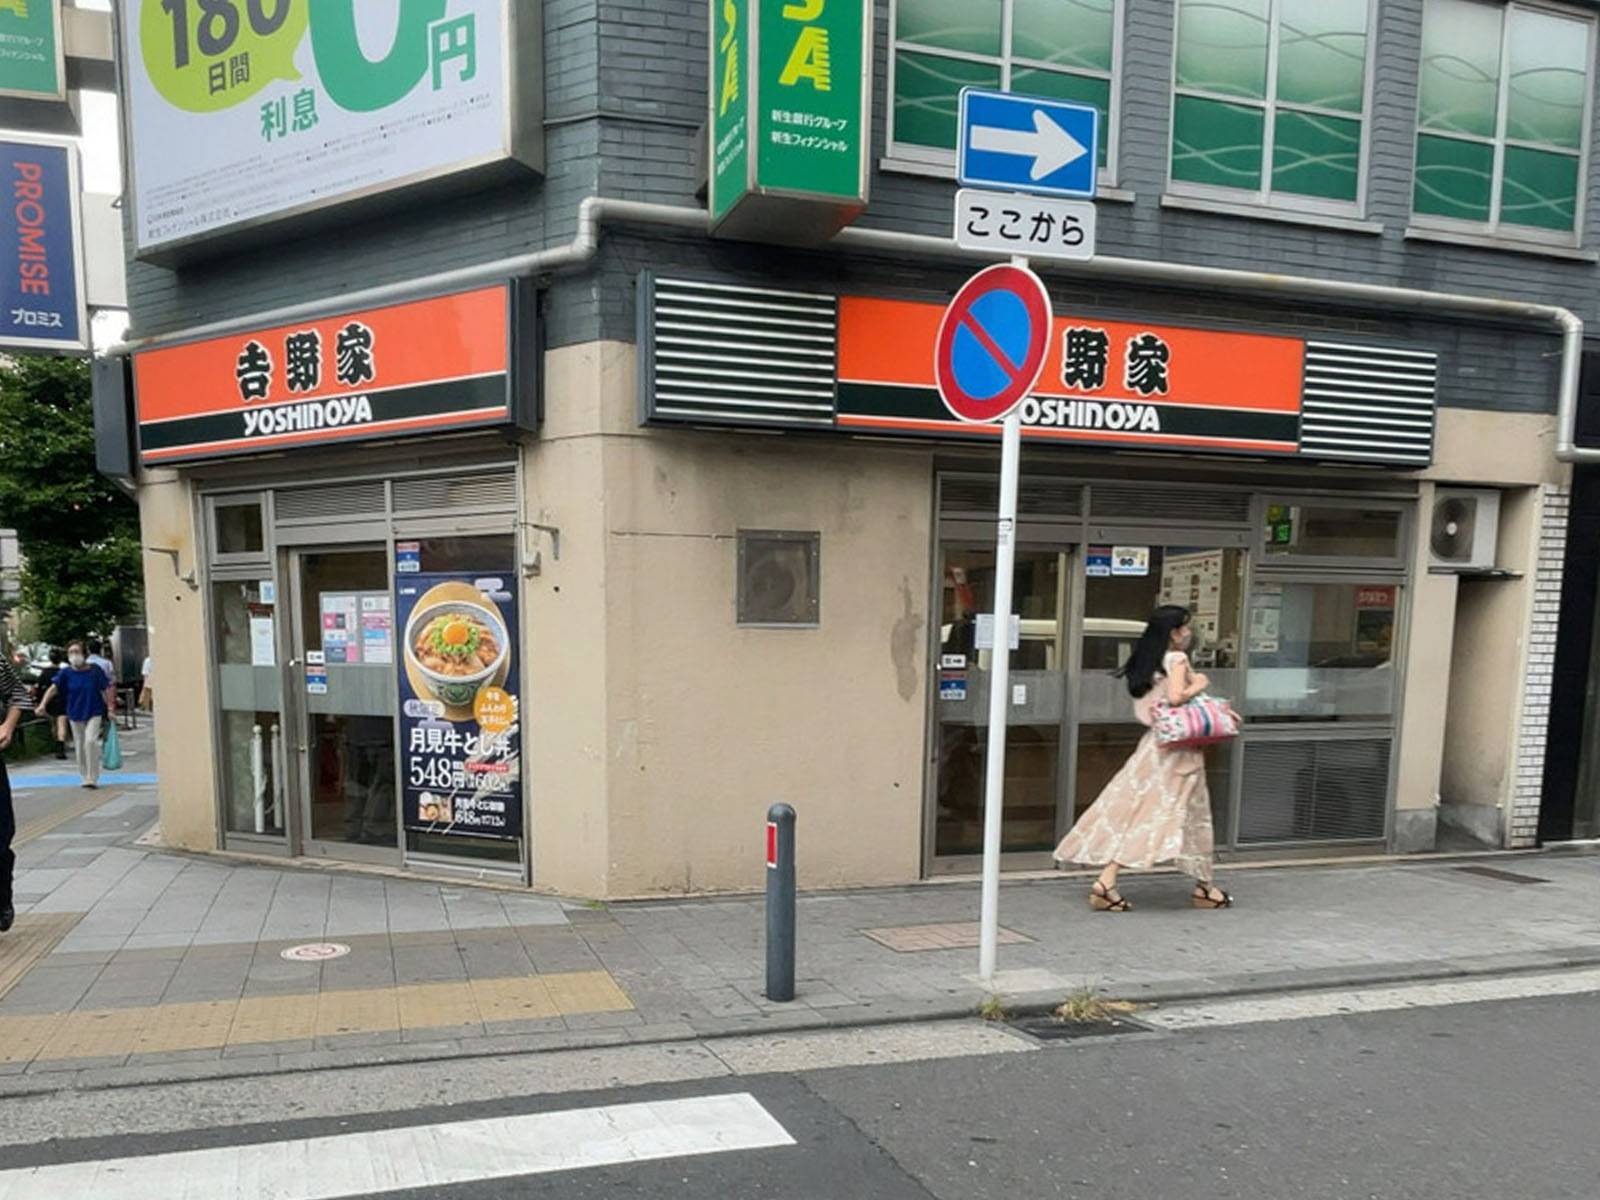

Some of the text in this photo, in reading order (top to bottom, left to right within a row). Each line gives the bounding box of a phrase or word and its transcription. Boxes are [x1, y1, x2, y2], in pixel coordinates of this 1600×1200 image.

[208, 51, 250, 96] 日間
[260, 88, 319, 143] 利息
[771, 108, 848, 132] 新生銀行グループ
[771, 130, 848, 153] 新生フィナンシャル
[13, 161, 50, 296] PROMISE
[967, 206, 1085, 246] ここから
[11, 308, 64, 328] プロミス
[236, 320, 376, 403] 吉野家
[1060, 325, 1171, 397] 野家
[243, 395, 373, 437] YOSHINOYA
[1019, 397, 1161, 432] OSHINOYA
